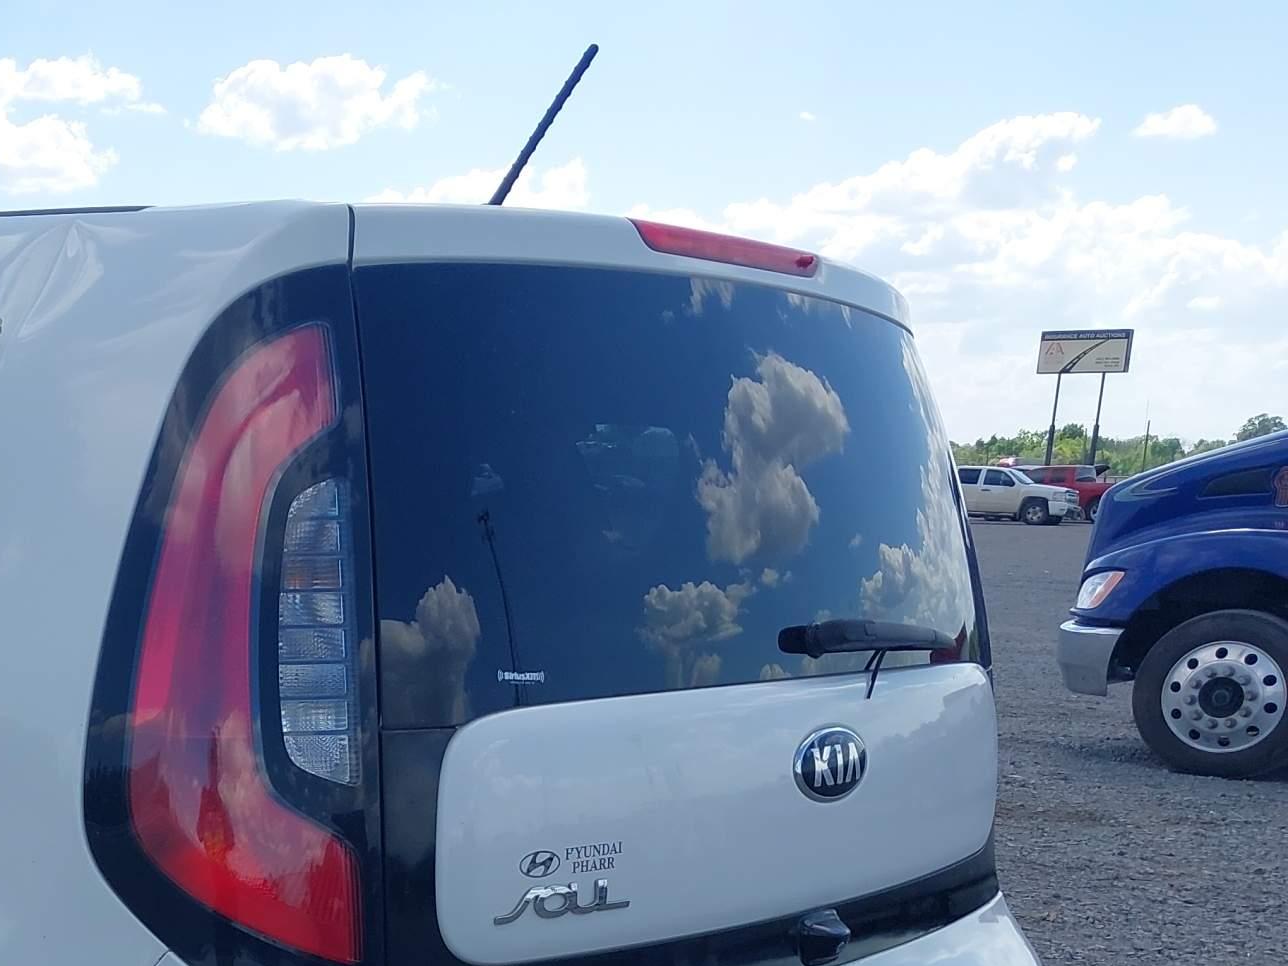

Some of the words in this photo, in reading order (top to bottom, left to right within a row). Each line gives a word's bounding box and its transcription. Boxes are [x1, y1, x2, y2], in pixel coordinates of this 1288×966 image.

[812, 742, 861, 788] KIA
[571, 856, 616, 874] PHARR
[493, 878, 631, 926] SOUL
